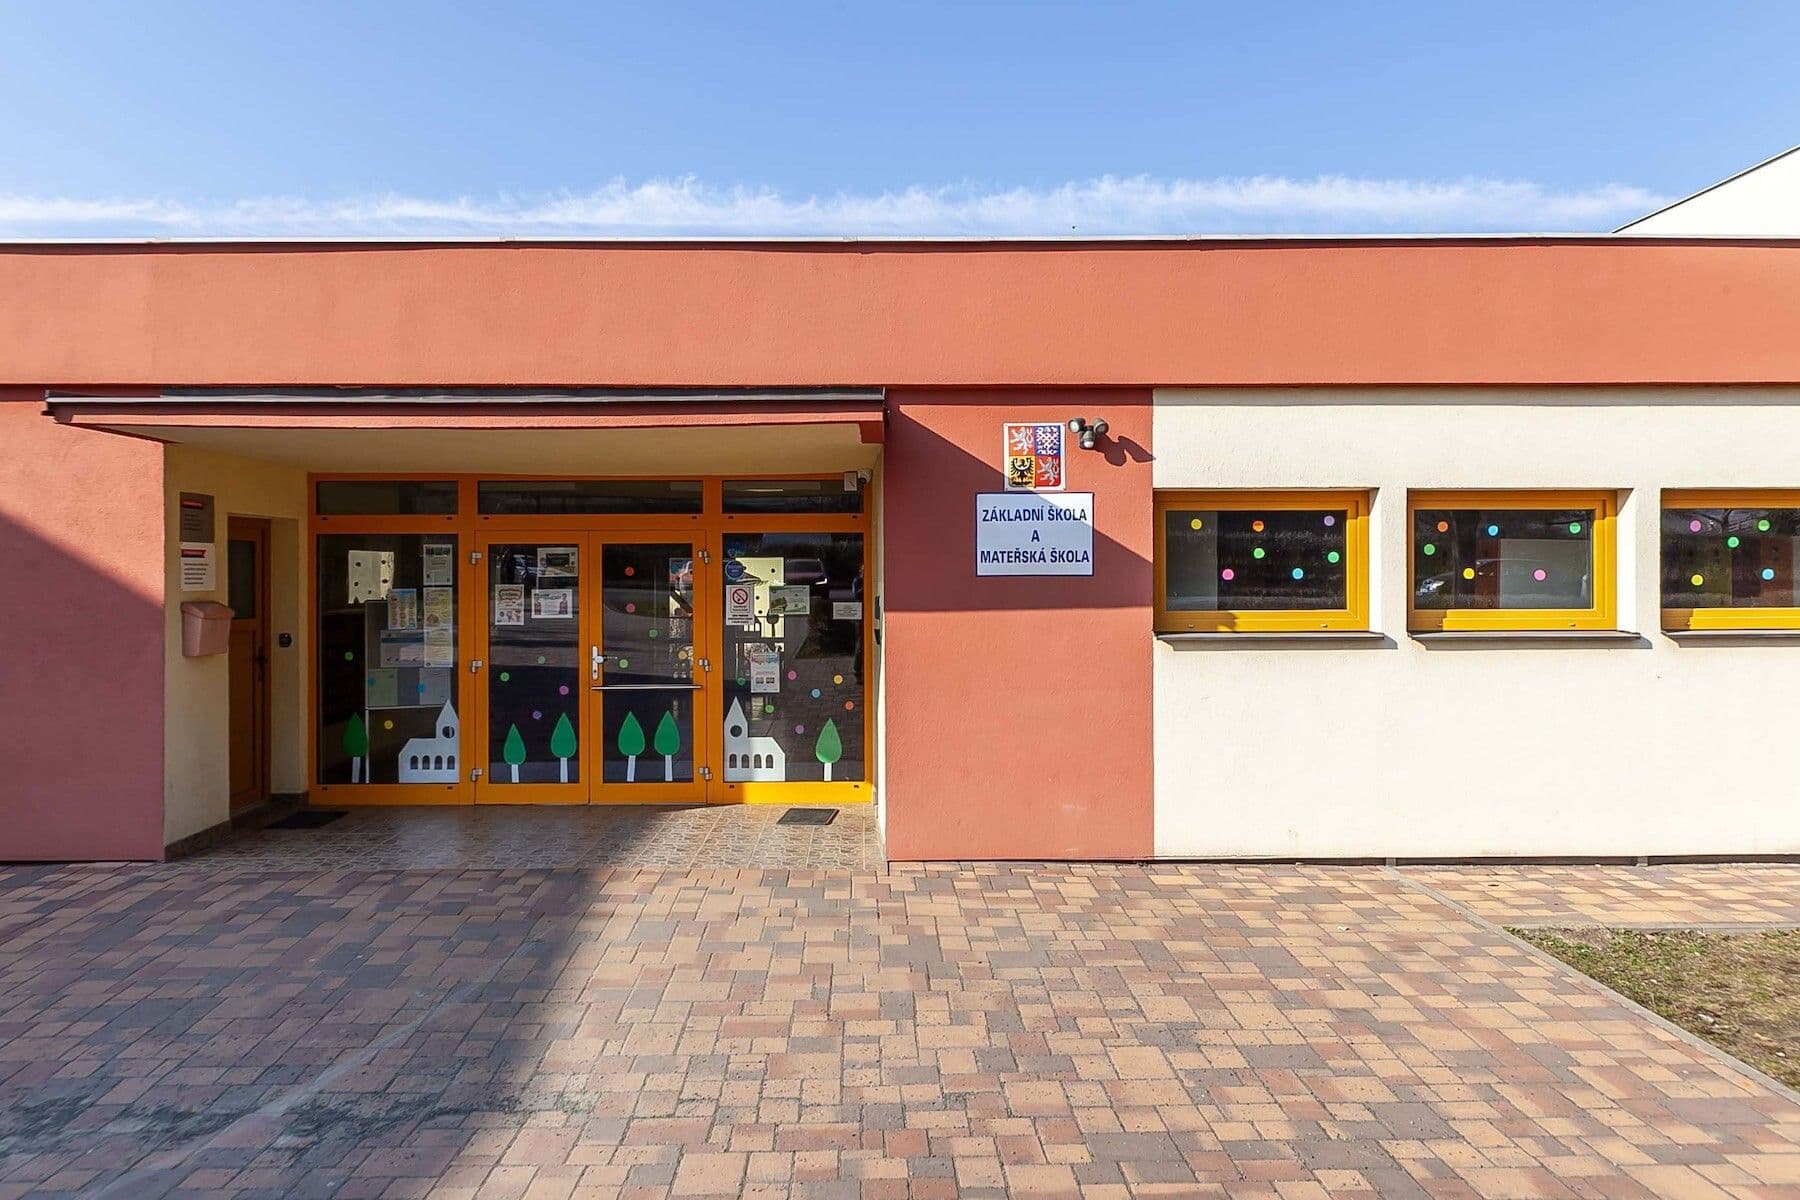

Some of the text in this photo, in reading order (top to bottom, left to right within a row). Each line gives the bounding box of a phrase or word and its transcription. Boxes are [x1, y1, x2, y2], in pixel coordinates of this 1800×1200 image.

[982, 505, 1087, 521] ZÁKLADNÍ ŠKOLA
[1031, 530, 1040, 542] A
[980, 547, 1089, 563] MATEŘSKÁ ŠKOLA
